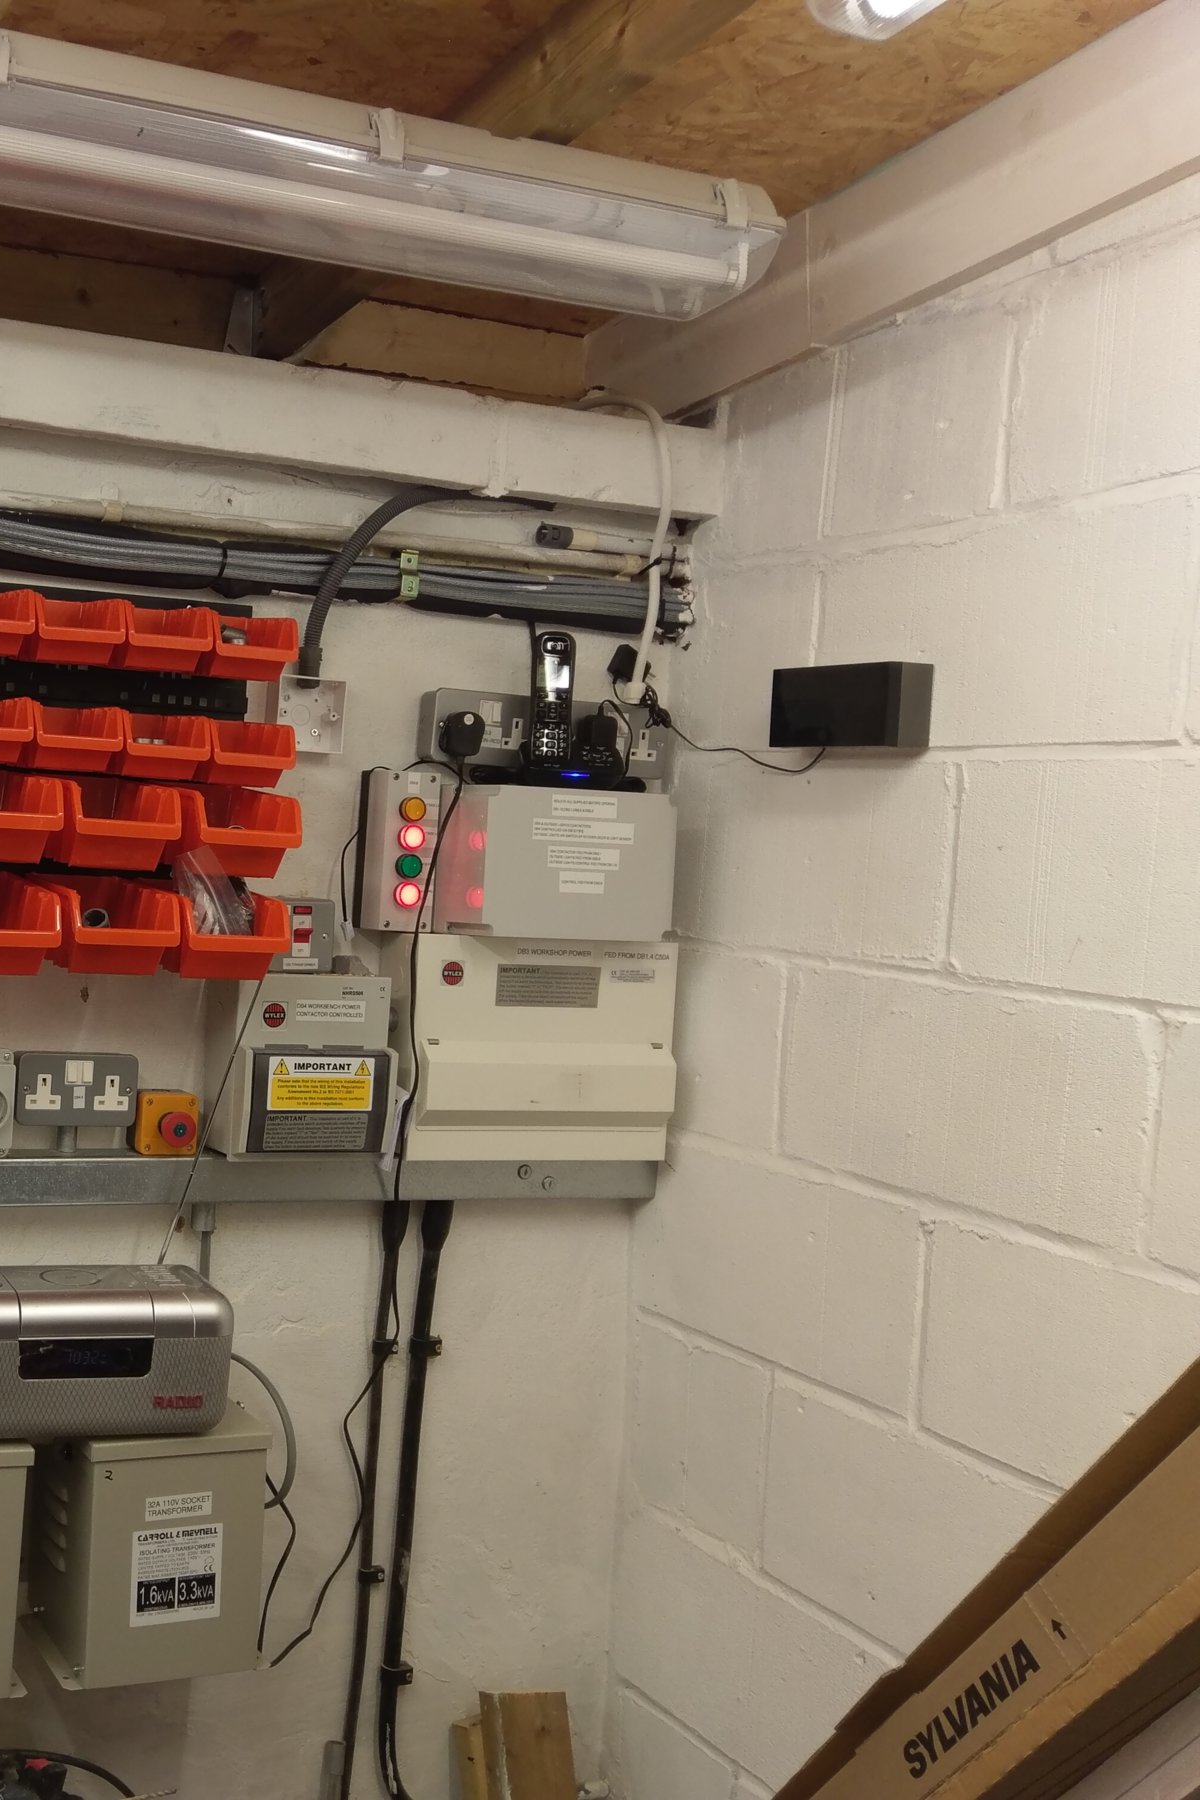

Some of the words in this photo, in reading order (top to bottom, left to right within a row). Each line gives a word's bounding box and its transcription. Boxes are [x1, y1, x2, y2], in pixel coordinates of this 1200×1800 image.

[531, 949, 568, 957] WORKSHOP
[104, 1470, 114, 1480] 2
[182, 1495, 210, 1504] SOCKET
[148, 1505, 203, 1517] TRANSFORMER
[138, 1532, 174, 1542] CARROLL
[182, 1527, 218, 1537] MEYNELL
[140, 1548, 170, 1556] ISOLATING
[172, 1543, 215, 1552] TRANSFORMER
[140, 1586, 174, 1605] 1.6kVA
[180, 1581, 213, 1601] 3.3kVA
[903, 1638, 1040, 1779] SYLVANIA
